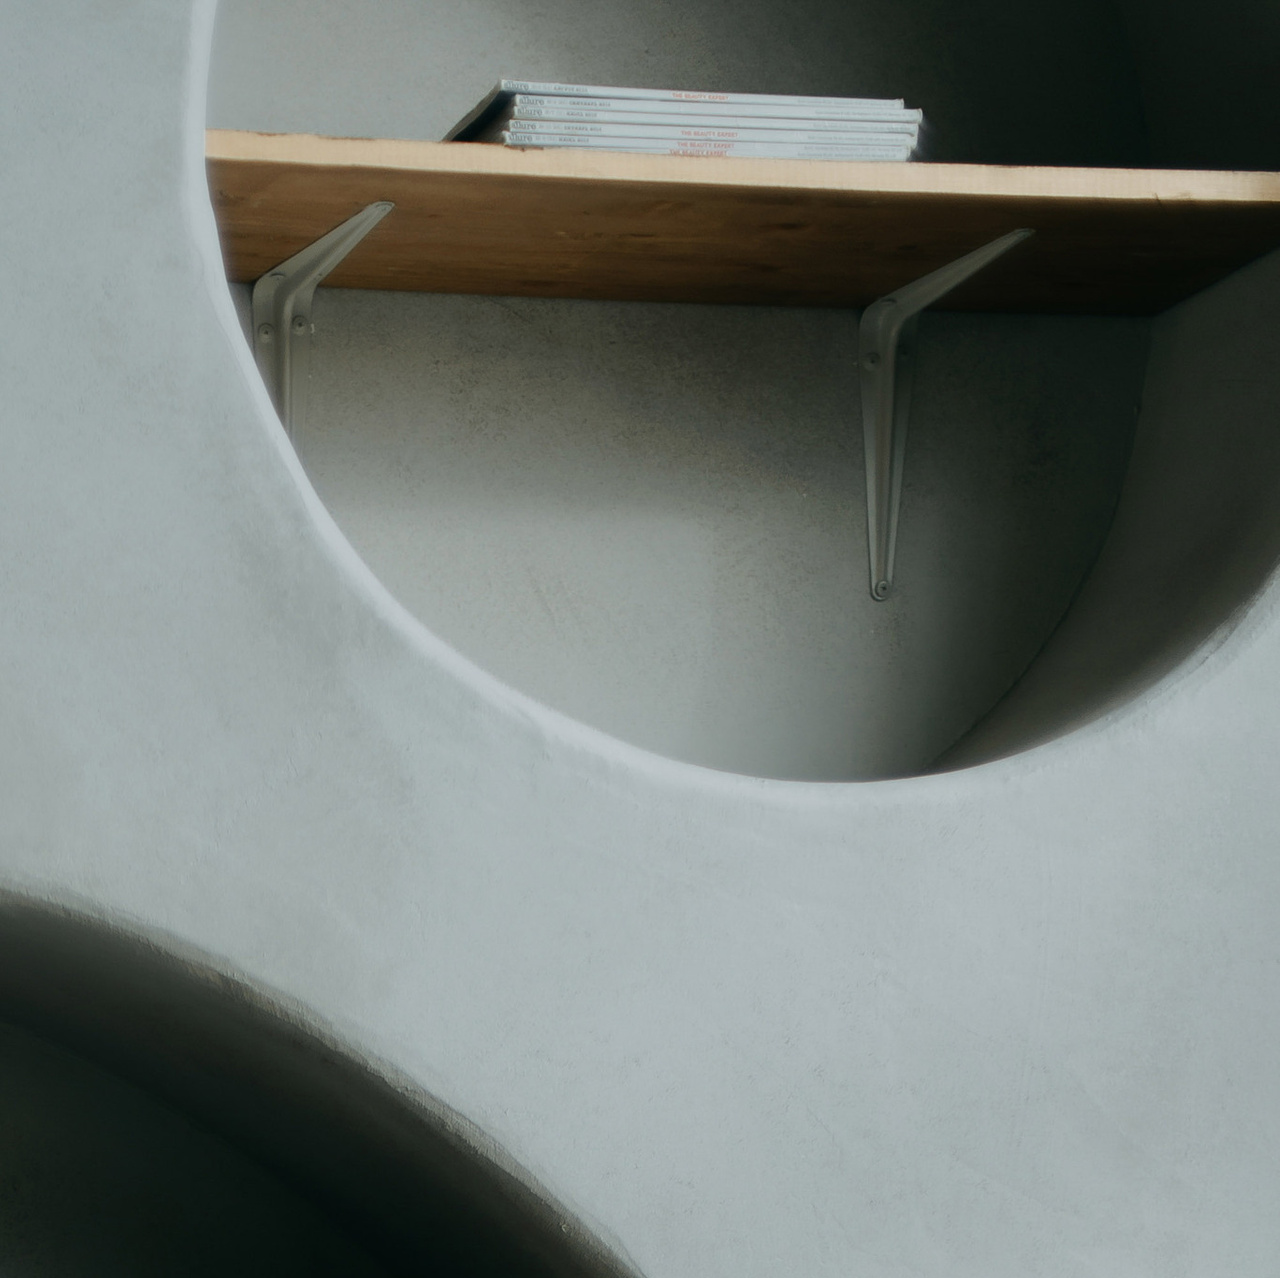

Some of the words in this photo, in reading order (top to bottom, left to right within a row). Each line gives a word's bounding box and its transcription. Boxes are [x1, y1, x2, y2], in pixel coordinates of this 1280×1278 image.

[519, 95, 544, 106] allure
[517, 106, 542, 116] allure
[512, 120, 536, 130] allure
[508, 132, 532, 142] allure
